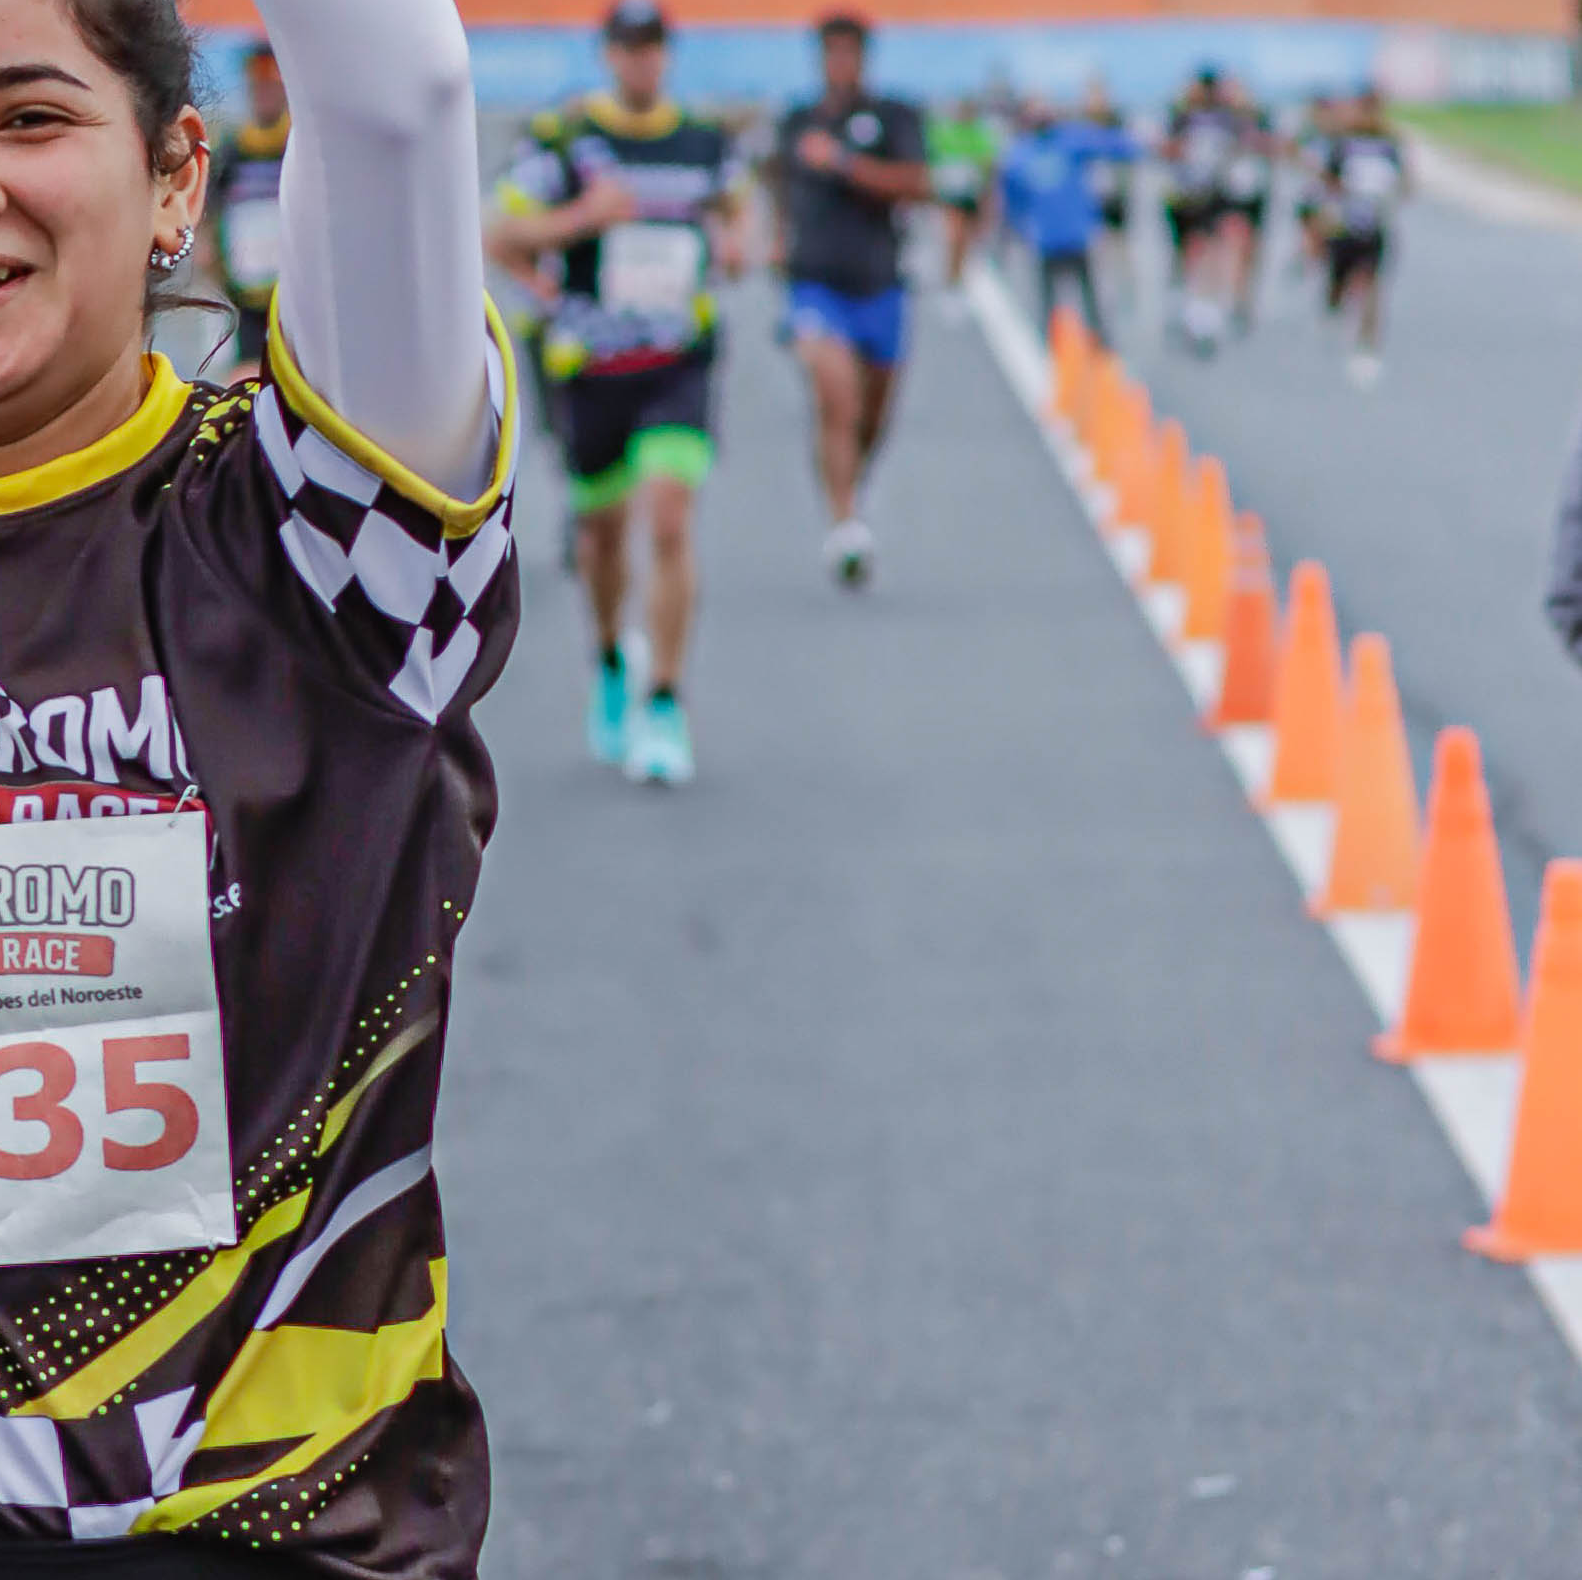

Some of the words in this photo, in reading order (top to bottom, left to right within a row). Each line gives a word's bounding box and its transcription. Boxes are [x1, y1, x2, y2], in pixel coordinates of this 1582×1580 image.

[1, 937, 82, 972] RACE
[27, 988, 57, 1008] del
[60, 985, 144, 1006] Noroeste
